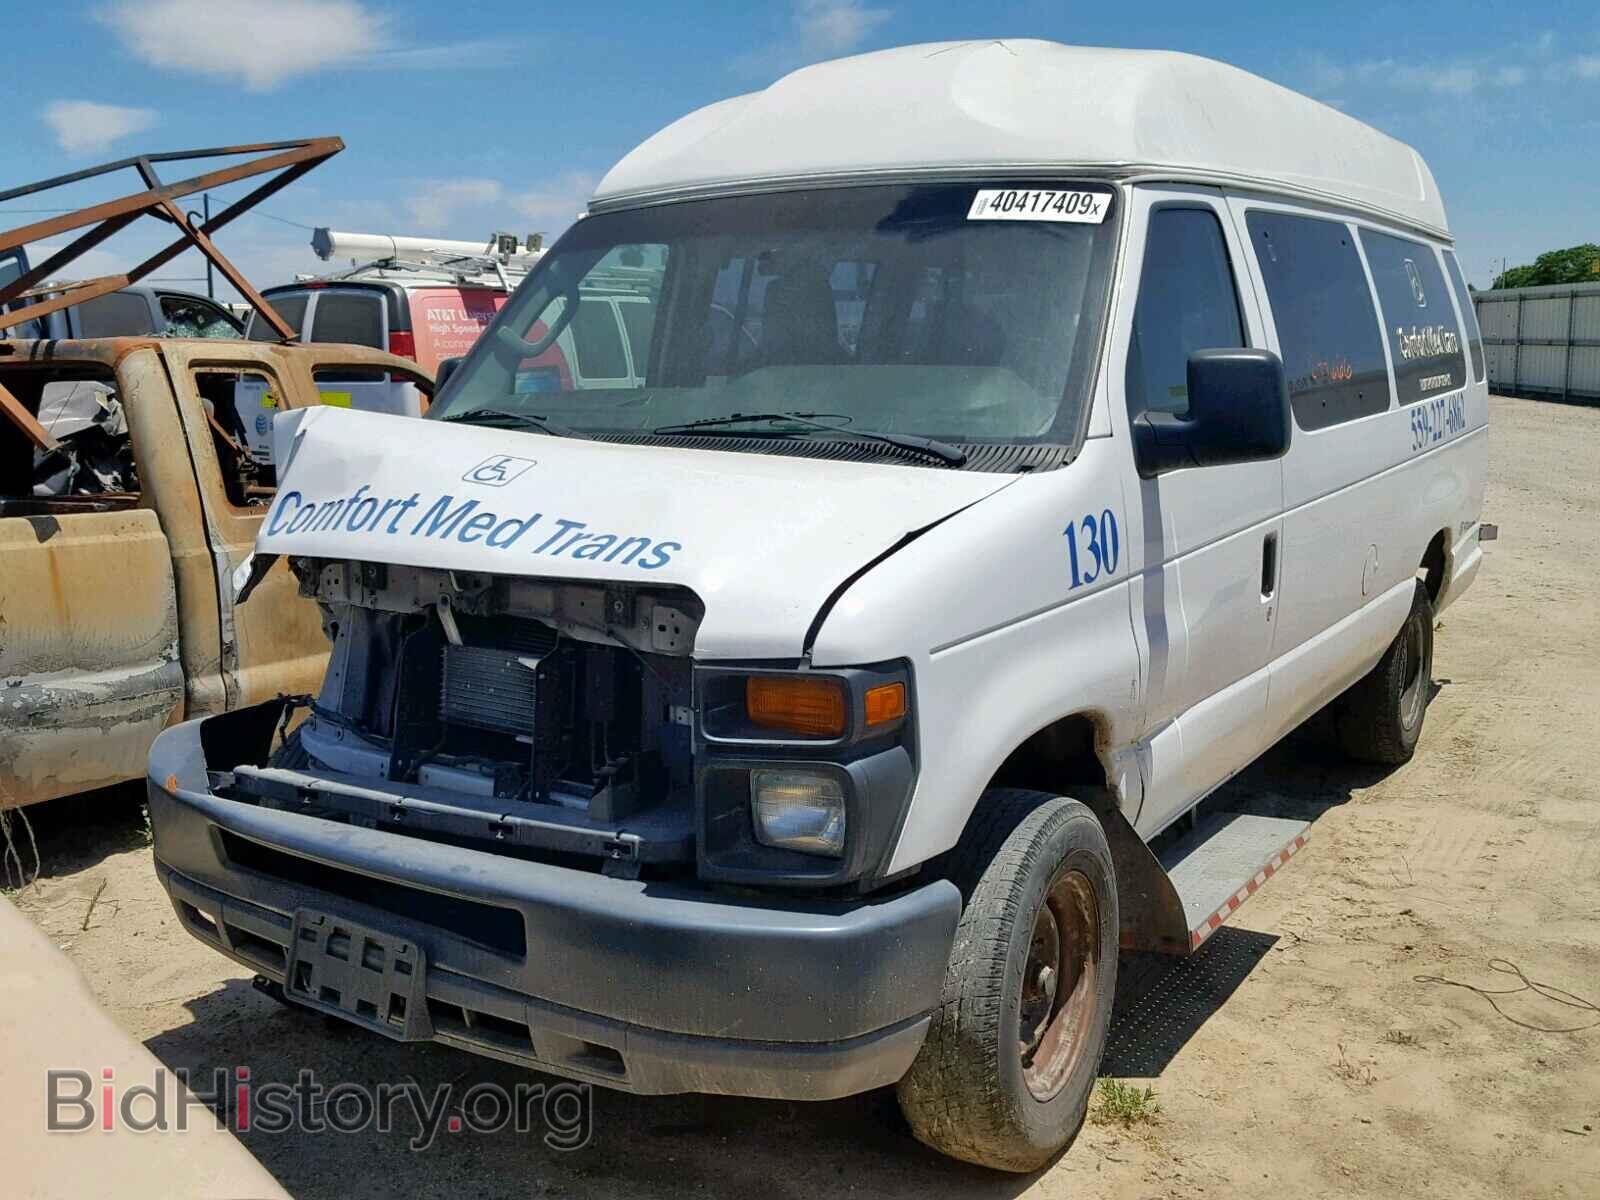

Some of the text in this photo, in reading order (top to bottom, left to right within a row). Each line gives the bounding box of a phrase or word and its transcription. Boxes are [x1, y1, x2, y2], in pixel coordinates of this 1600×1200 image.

[427, 308, 458, 321] AT&T
[266, 484, 683, 571] Comfort Med Trans
[1063, 509, 1119, 590] 130
